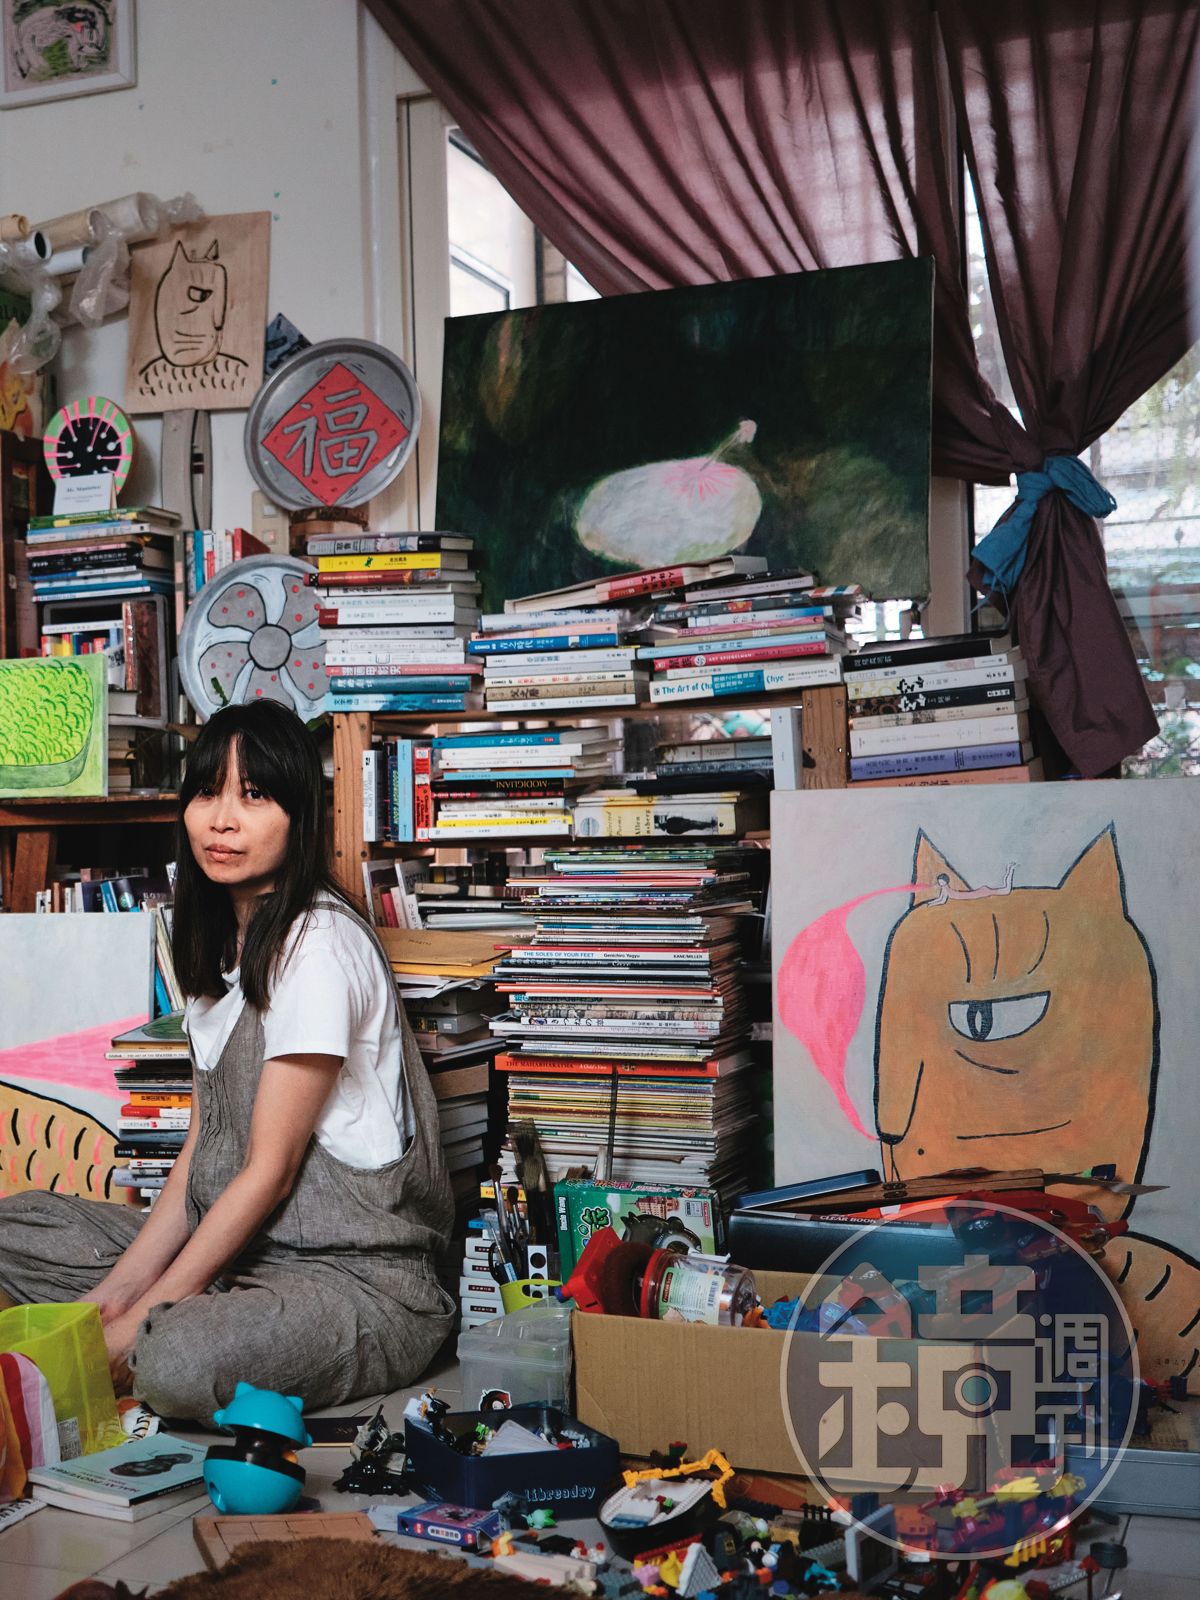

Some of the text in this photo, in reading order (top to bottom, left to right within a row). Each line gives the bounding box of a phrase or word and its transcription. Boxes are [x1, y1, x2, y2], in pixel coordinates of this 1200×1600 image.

[282, 389, 378, 478] 福
[662, 685, 676, 695] The
[677, 683, 690, 693] Art
[691, 682, 699, 692] of
[766, 673, 784, 685] Chye
[495, 780, 548, 789] MODIGLIANI
[563, 951, 579, 959] YOUR
[558, 1196, 569, 1231] Uncle Wang
[525, 1484, 596, 1502] libreadry
